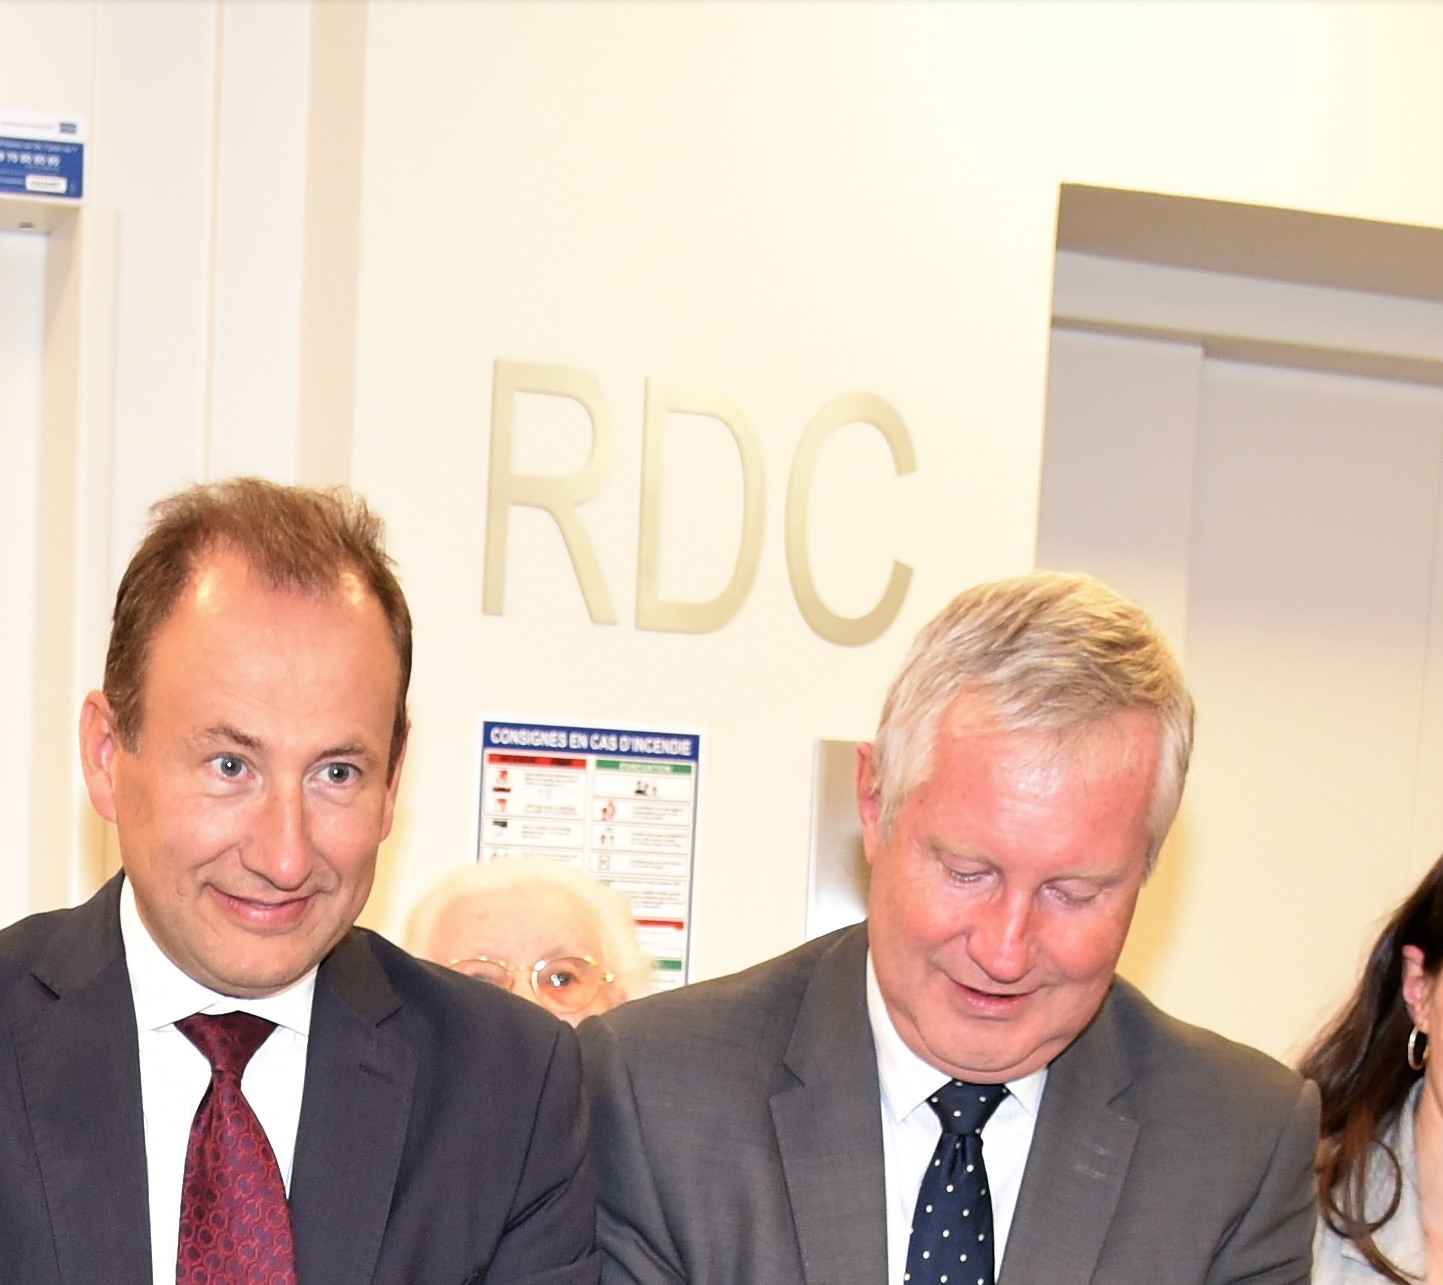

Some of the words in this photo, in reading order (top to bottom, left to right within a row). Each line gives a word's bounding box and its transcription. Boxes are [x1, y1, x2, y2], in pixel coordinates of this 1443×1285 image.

[481, 358, 917, 648] RDC
[490, 727, 568, 748] CONSIGNES
[569, 732, 588, 749] EN
[590, 734, 617, 751] CAS
